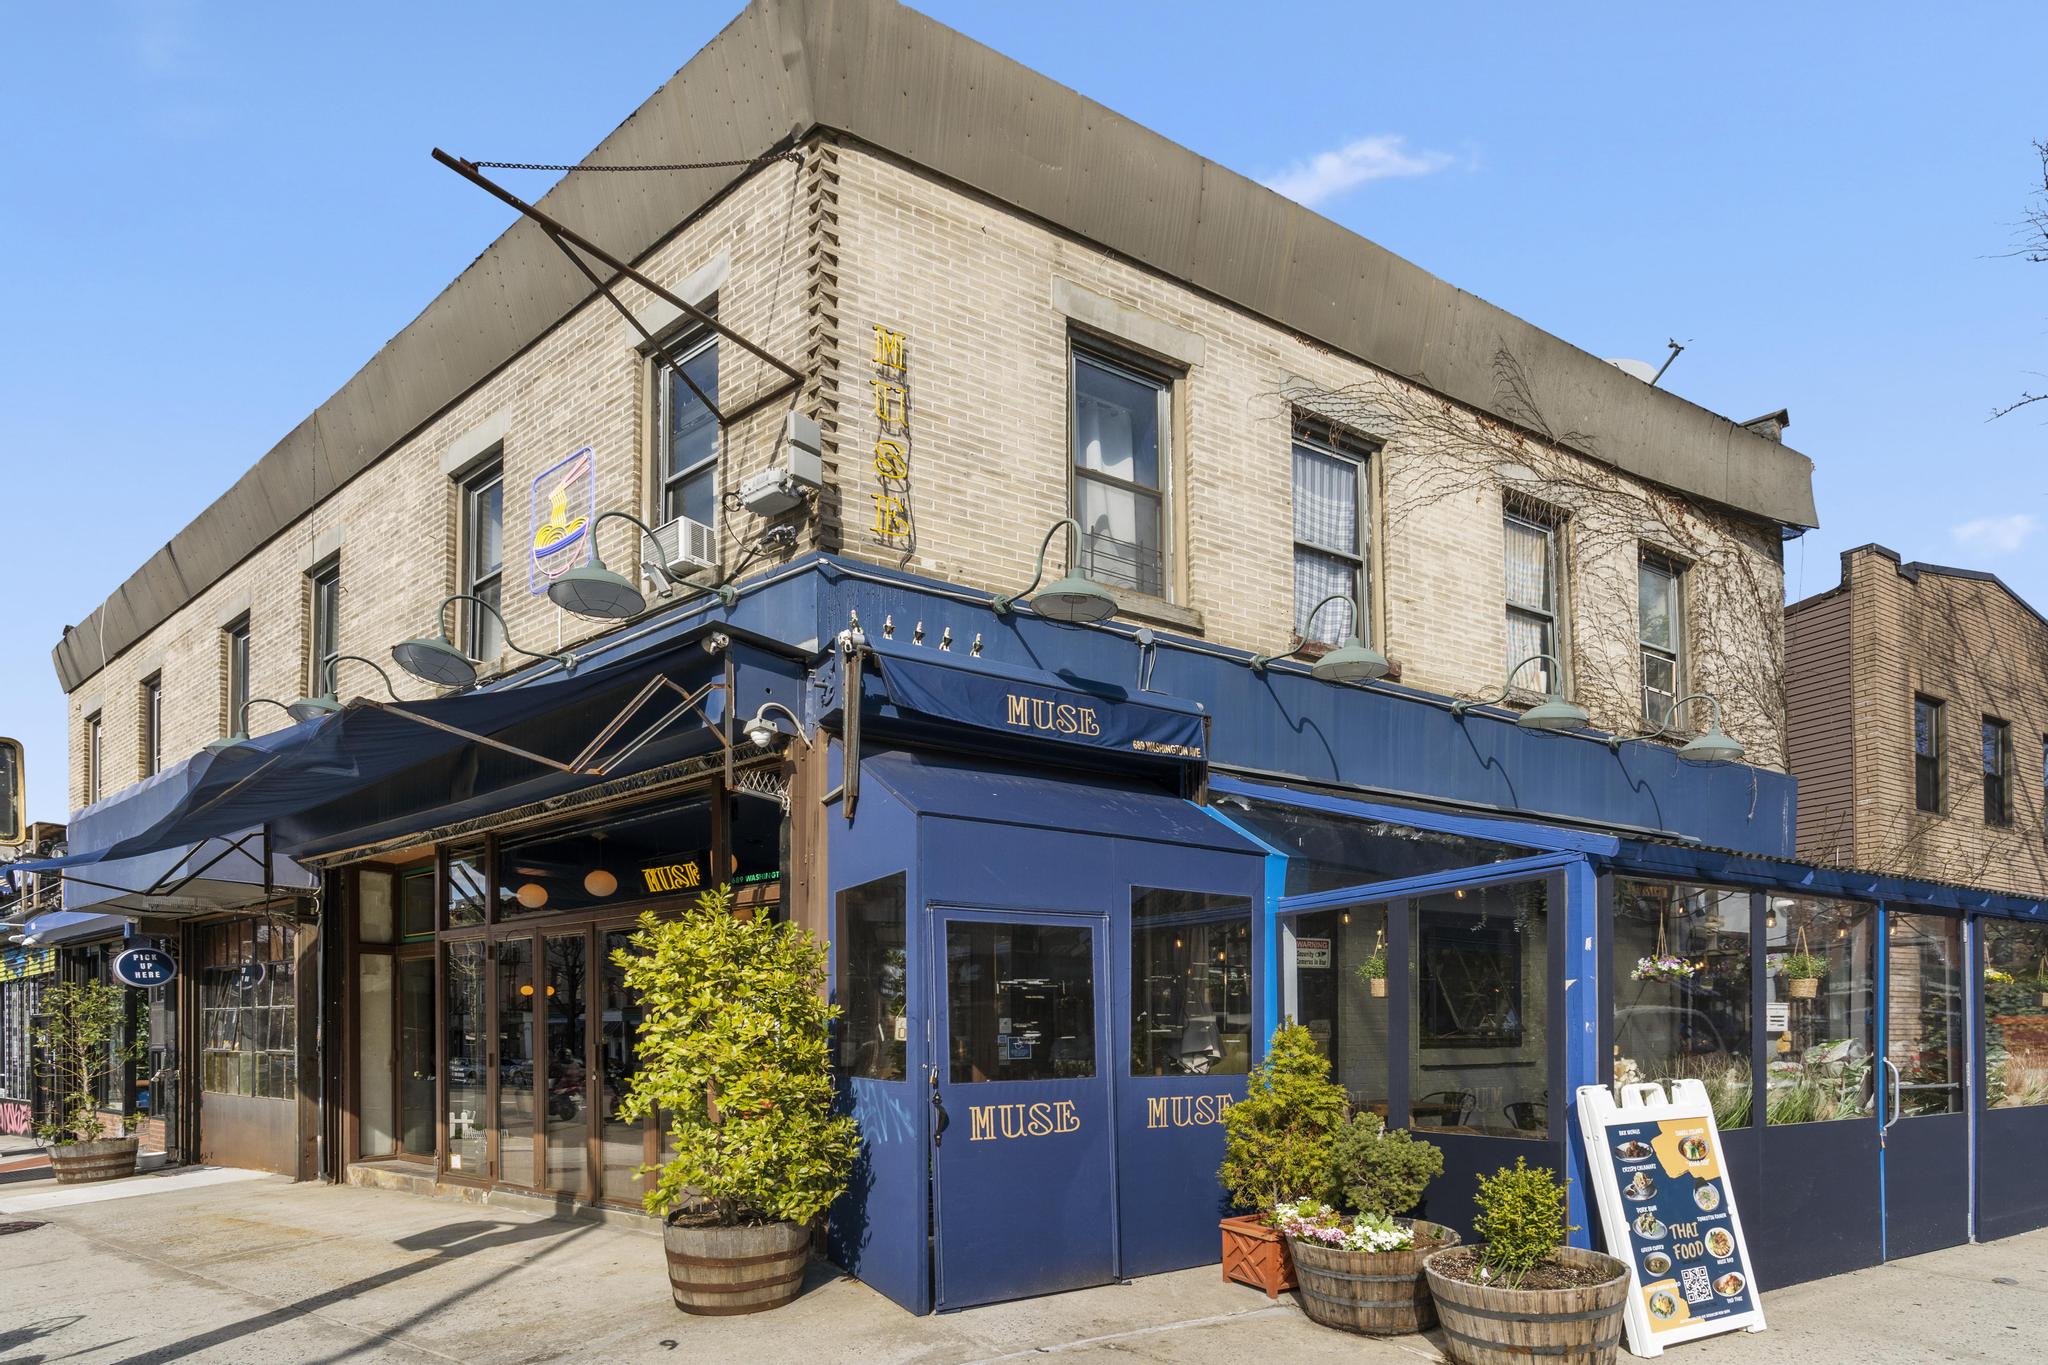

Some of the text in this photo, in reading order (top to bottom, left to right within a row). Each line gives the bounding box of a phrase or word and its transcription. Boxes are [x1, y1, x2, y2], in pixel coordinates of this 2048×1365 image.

[869, 324, 910, 536] MUSE
[1006, 694, 1100, 736] MUSE
[1132, 739, 1202, 758] 689 WASHINGTON AVE
[745, 870, 781, 883] WASHINGT
[1297, 941, 1328, 949] WARNING
[133, 953, 158, 961] PICK
[134, 971, 161, 979] HERE
[969, 1100, 1081, 1140] MUSE
[1669, 1221, 1699, 1240] THAI
[1672, 1240, 1704, 1260] FOOD
